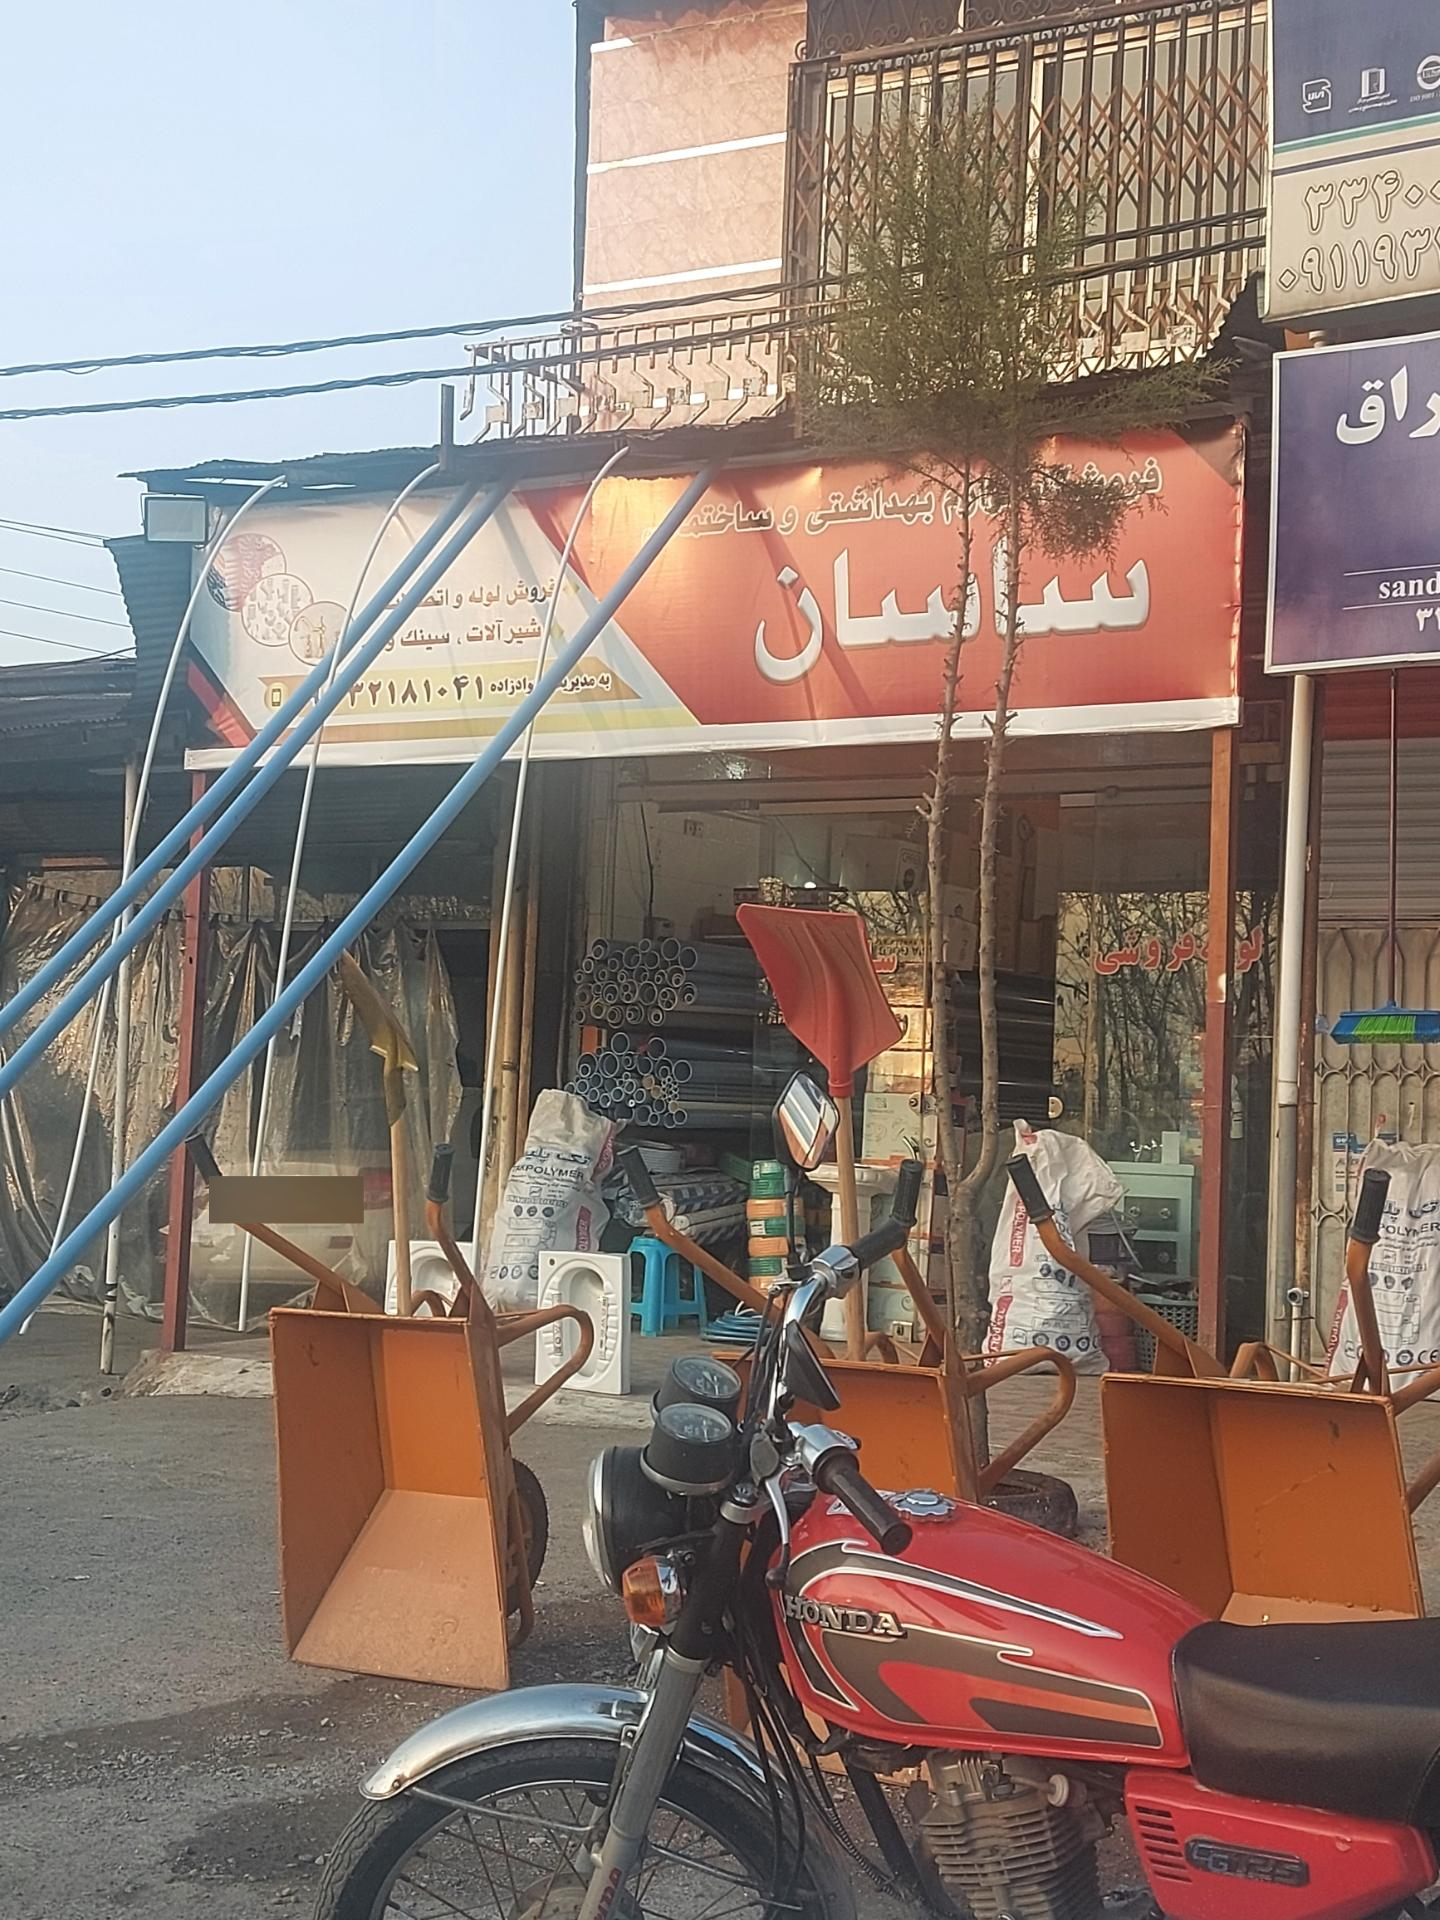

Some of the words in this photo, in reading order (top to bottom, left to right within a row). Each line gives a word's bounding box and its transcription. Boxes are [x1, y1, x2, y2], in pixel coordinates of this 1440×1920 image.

[1278, 226, 1440, 293] ۰۹۱۱۹۳
[777, 504, 798, 535] و
[804, 484, 936, 534] بهداشتی
[452, 593, 463, 609] و
[469, 585, 500, 607] لوله
[754, 535, 1151, 683] ساسان
[559, 677, 595, 692] مدیری
[599, 675, 611, 689] به
[1094, 917, 1196, 976] فروشی
[784, 1594, 904, 1638] HONDA
